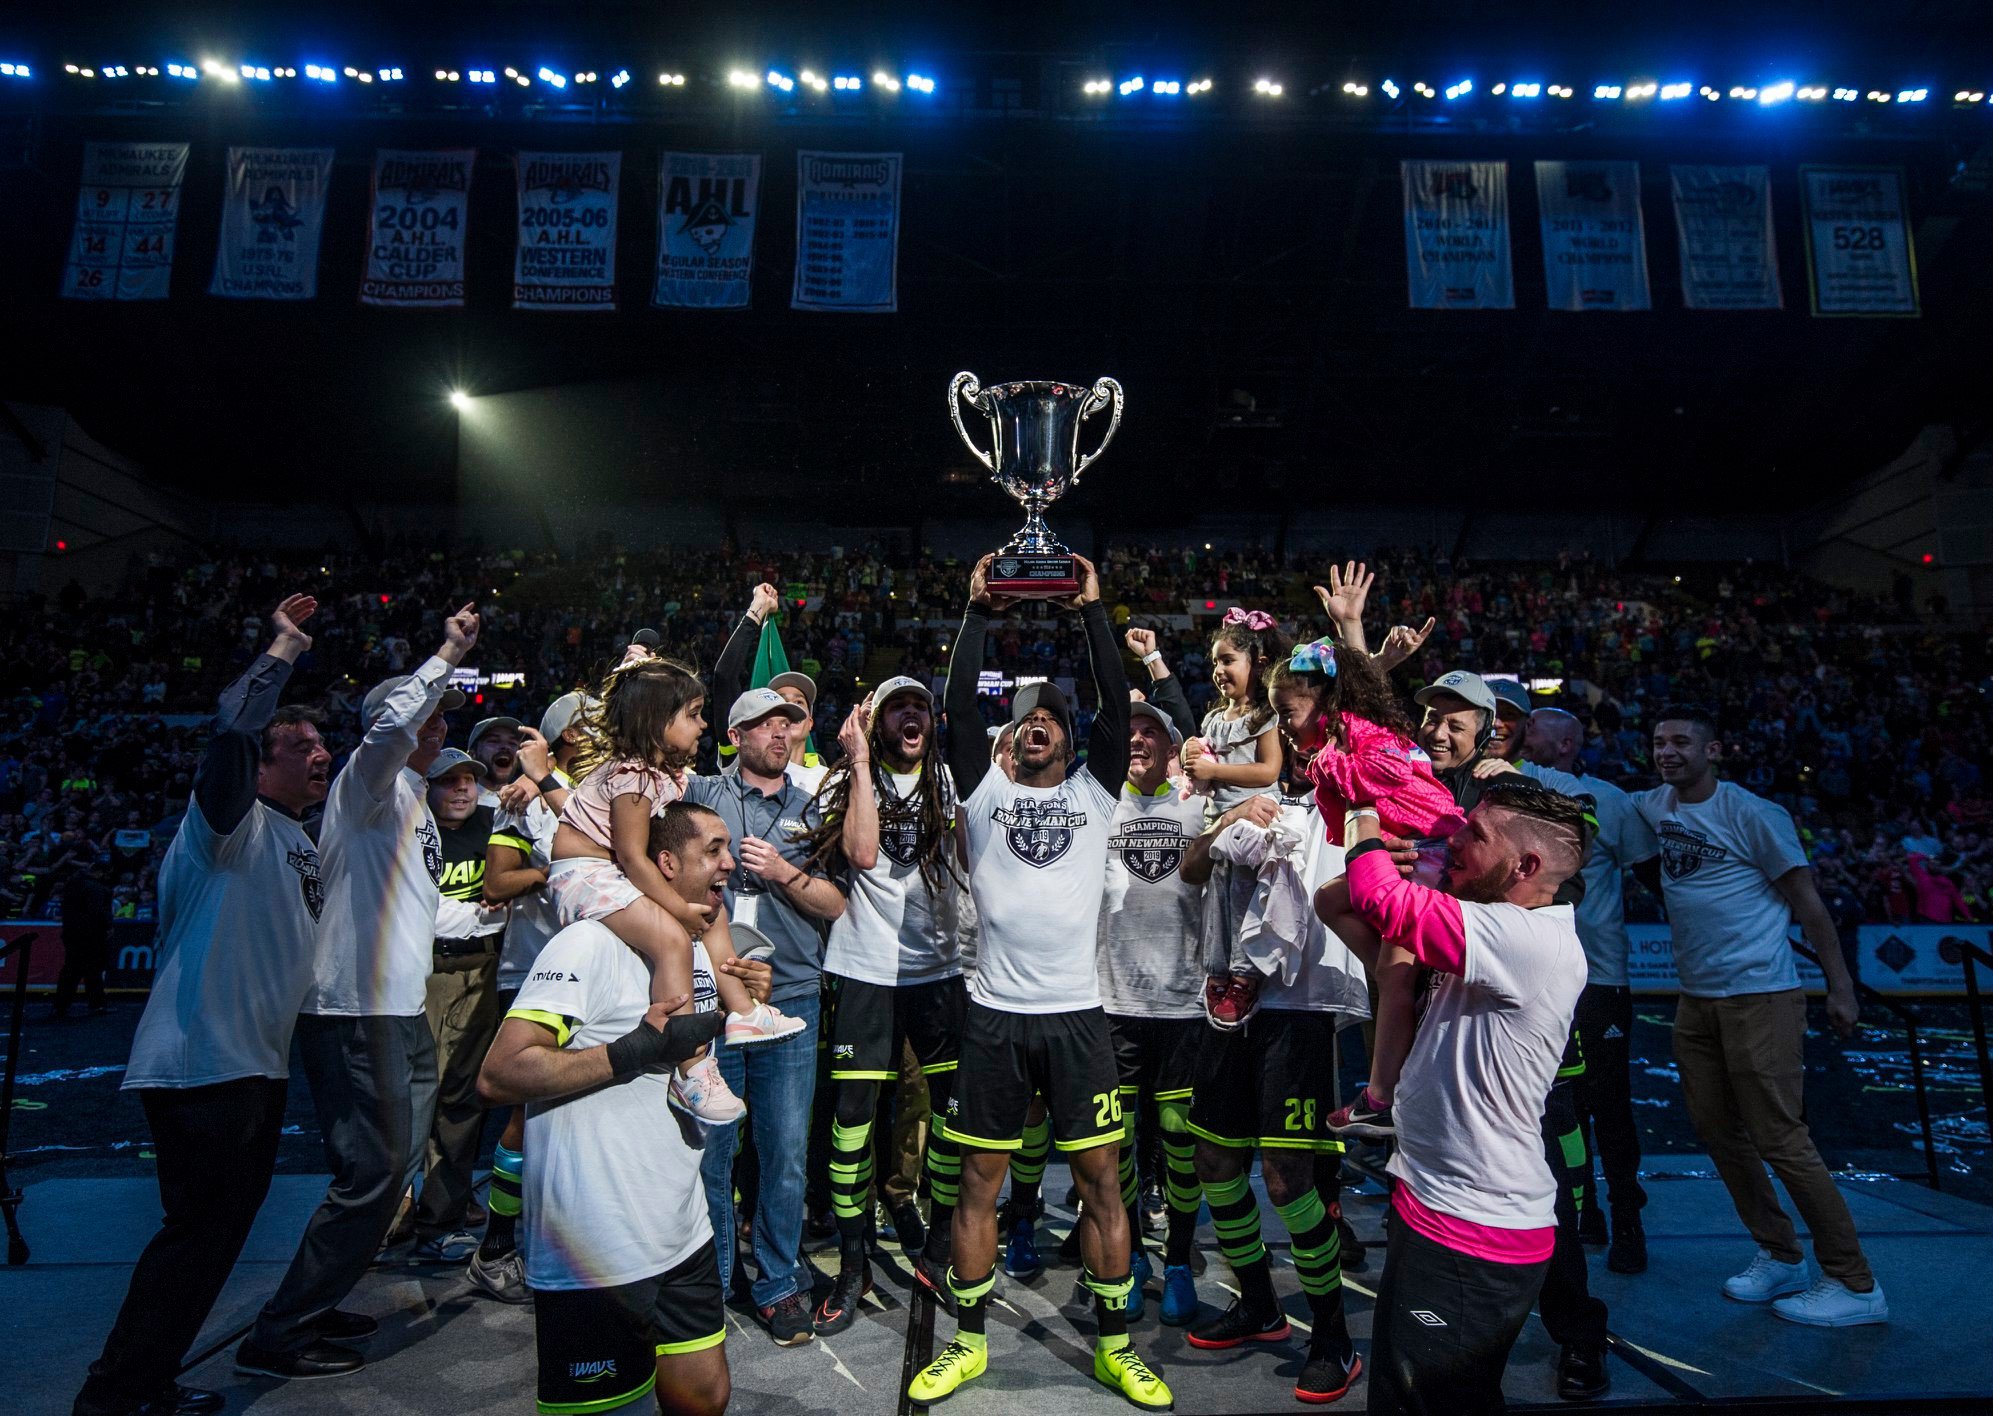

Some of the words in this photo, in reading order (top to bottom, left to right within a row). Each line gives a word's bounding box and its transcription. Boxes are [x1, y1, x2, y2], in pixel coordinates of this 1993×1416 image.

[98, 163, 169, 176] ADMIRALS
[379, 161, 467, 190] ADMIRALS
[525, 161, 610, 191] ADMIRALS
[810, 158, 890, 187] ADMIRALS
[97, 190, 109, 208] 9
[142, 191, 171, 209] 27
[666, 176, 750, 217] AHL
[379, 205, 459, 231] 2004
[521, 207, 608, 228] 2005-06
[85, 236, 106, 254] 14
[136, 236, 163, 254] 44
[1833, 226, 1885, 250] 528
[374, 246, 457, 263] CALDER
[521, 247, 606, 266] WESTERN
[661, 254, 704, 268] REGULAR
[707, 256, 750, 269] SEASON
[78, 269, 102, 288] 26
[389, 262, 437, 279] CUP
[521, 266, 605, 279] CONFERENCE
[659, 268, 695, 280] WESTERN
[697, 269, 748, 282] CONFERENCE
[223, 279, 304, 294] CHAMPIONS
[363, 281, 464, 298] CHAMPIONS
[514, 286, 612, 302] CHAMPIONS
[475, 677, 489, 685] CUP
[996, 809, 1018, 826] RON
[1068, 814, 1087, 828] CUP
[1124, 822, 1179, 833] CHAMPIONS
[900, 834, 915, 843] 2019
[1033, 830, 1048, 841] 2019
[1108, 838, 1128, 848] RON
[1129, 838, 1178, 848] NEWMAN
[1179, 838, 1193, 848] CU
[1145, 851, 1160, 860] 2019
[1701, 846, 1723, 858] CUP
[440, 860, 486, 886] AV
[532, 970, 564, 981] mitre
[1093, 1089, 1122, 1128] 26
[1285, 1098, 1316, 1131] 28
[575, 1359, 617, 1377] WAVE
